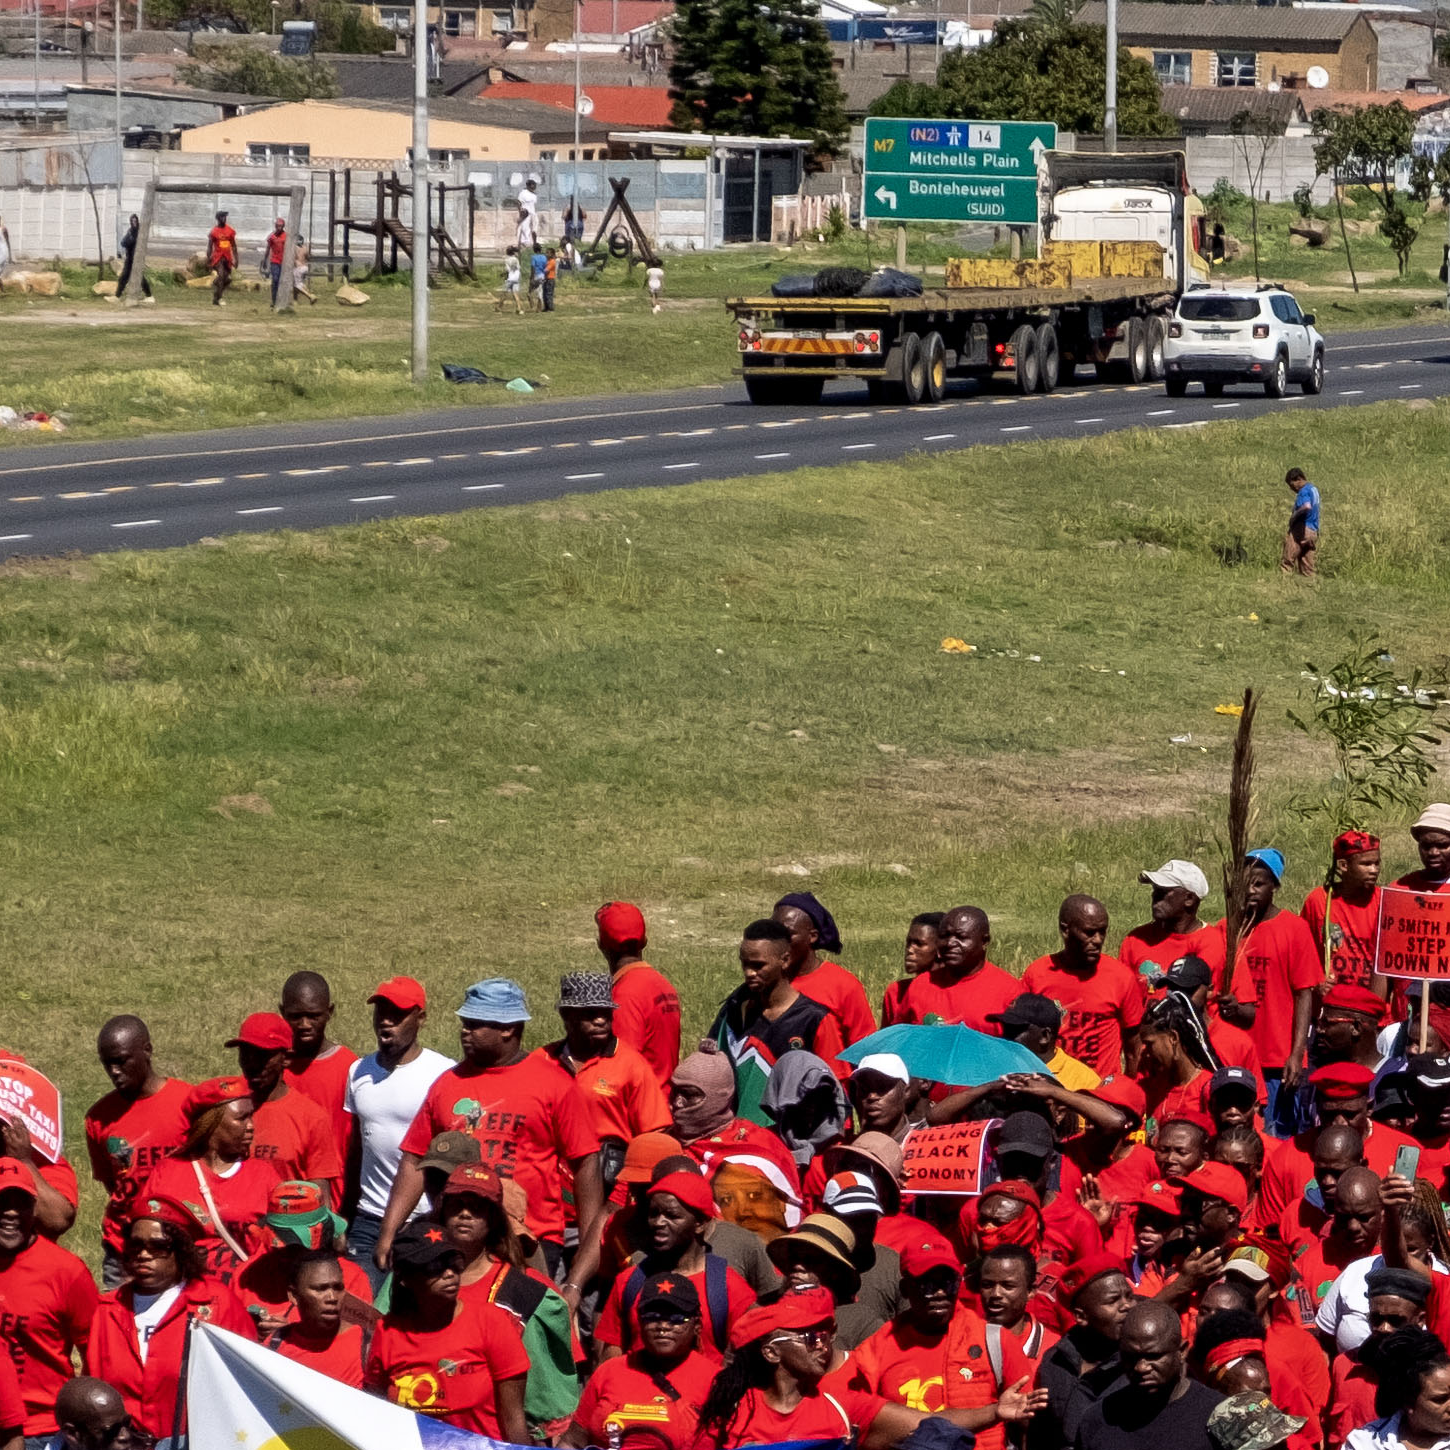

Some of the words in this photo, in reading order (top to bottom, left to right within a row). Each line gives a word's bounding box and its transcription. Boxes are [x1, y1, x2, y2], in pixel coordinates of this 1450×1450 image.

[909, 127, 940, 142] (N2)
[978, 130, 992, 143] 14
[873, 138, 895, 153] M7
[909, 151, 976, 167] Mitchells
[982, 153, 1020, 168] Plain
[909, 180, 1005, 197] Bonteheuwel
[966, 203, 1005, 216] (SUID)
[1381, 919, 1397, 935] JP
[1398, 919, 1440, 935] SMITH
[1407, 939, 1447, 955] STEP
[1384, 954, 1430, 973] DOWN
[28, 1102, 56, 1133] TAXI
[486, 1112, 526, 1133] EFF
[908, 1129, 981, 1145] KILLING
[904, 1144, 970, 1161] BLACK
[905, 1166, 976, 1182] CONOMY
